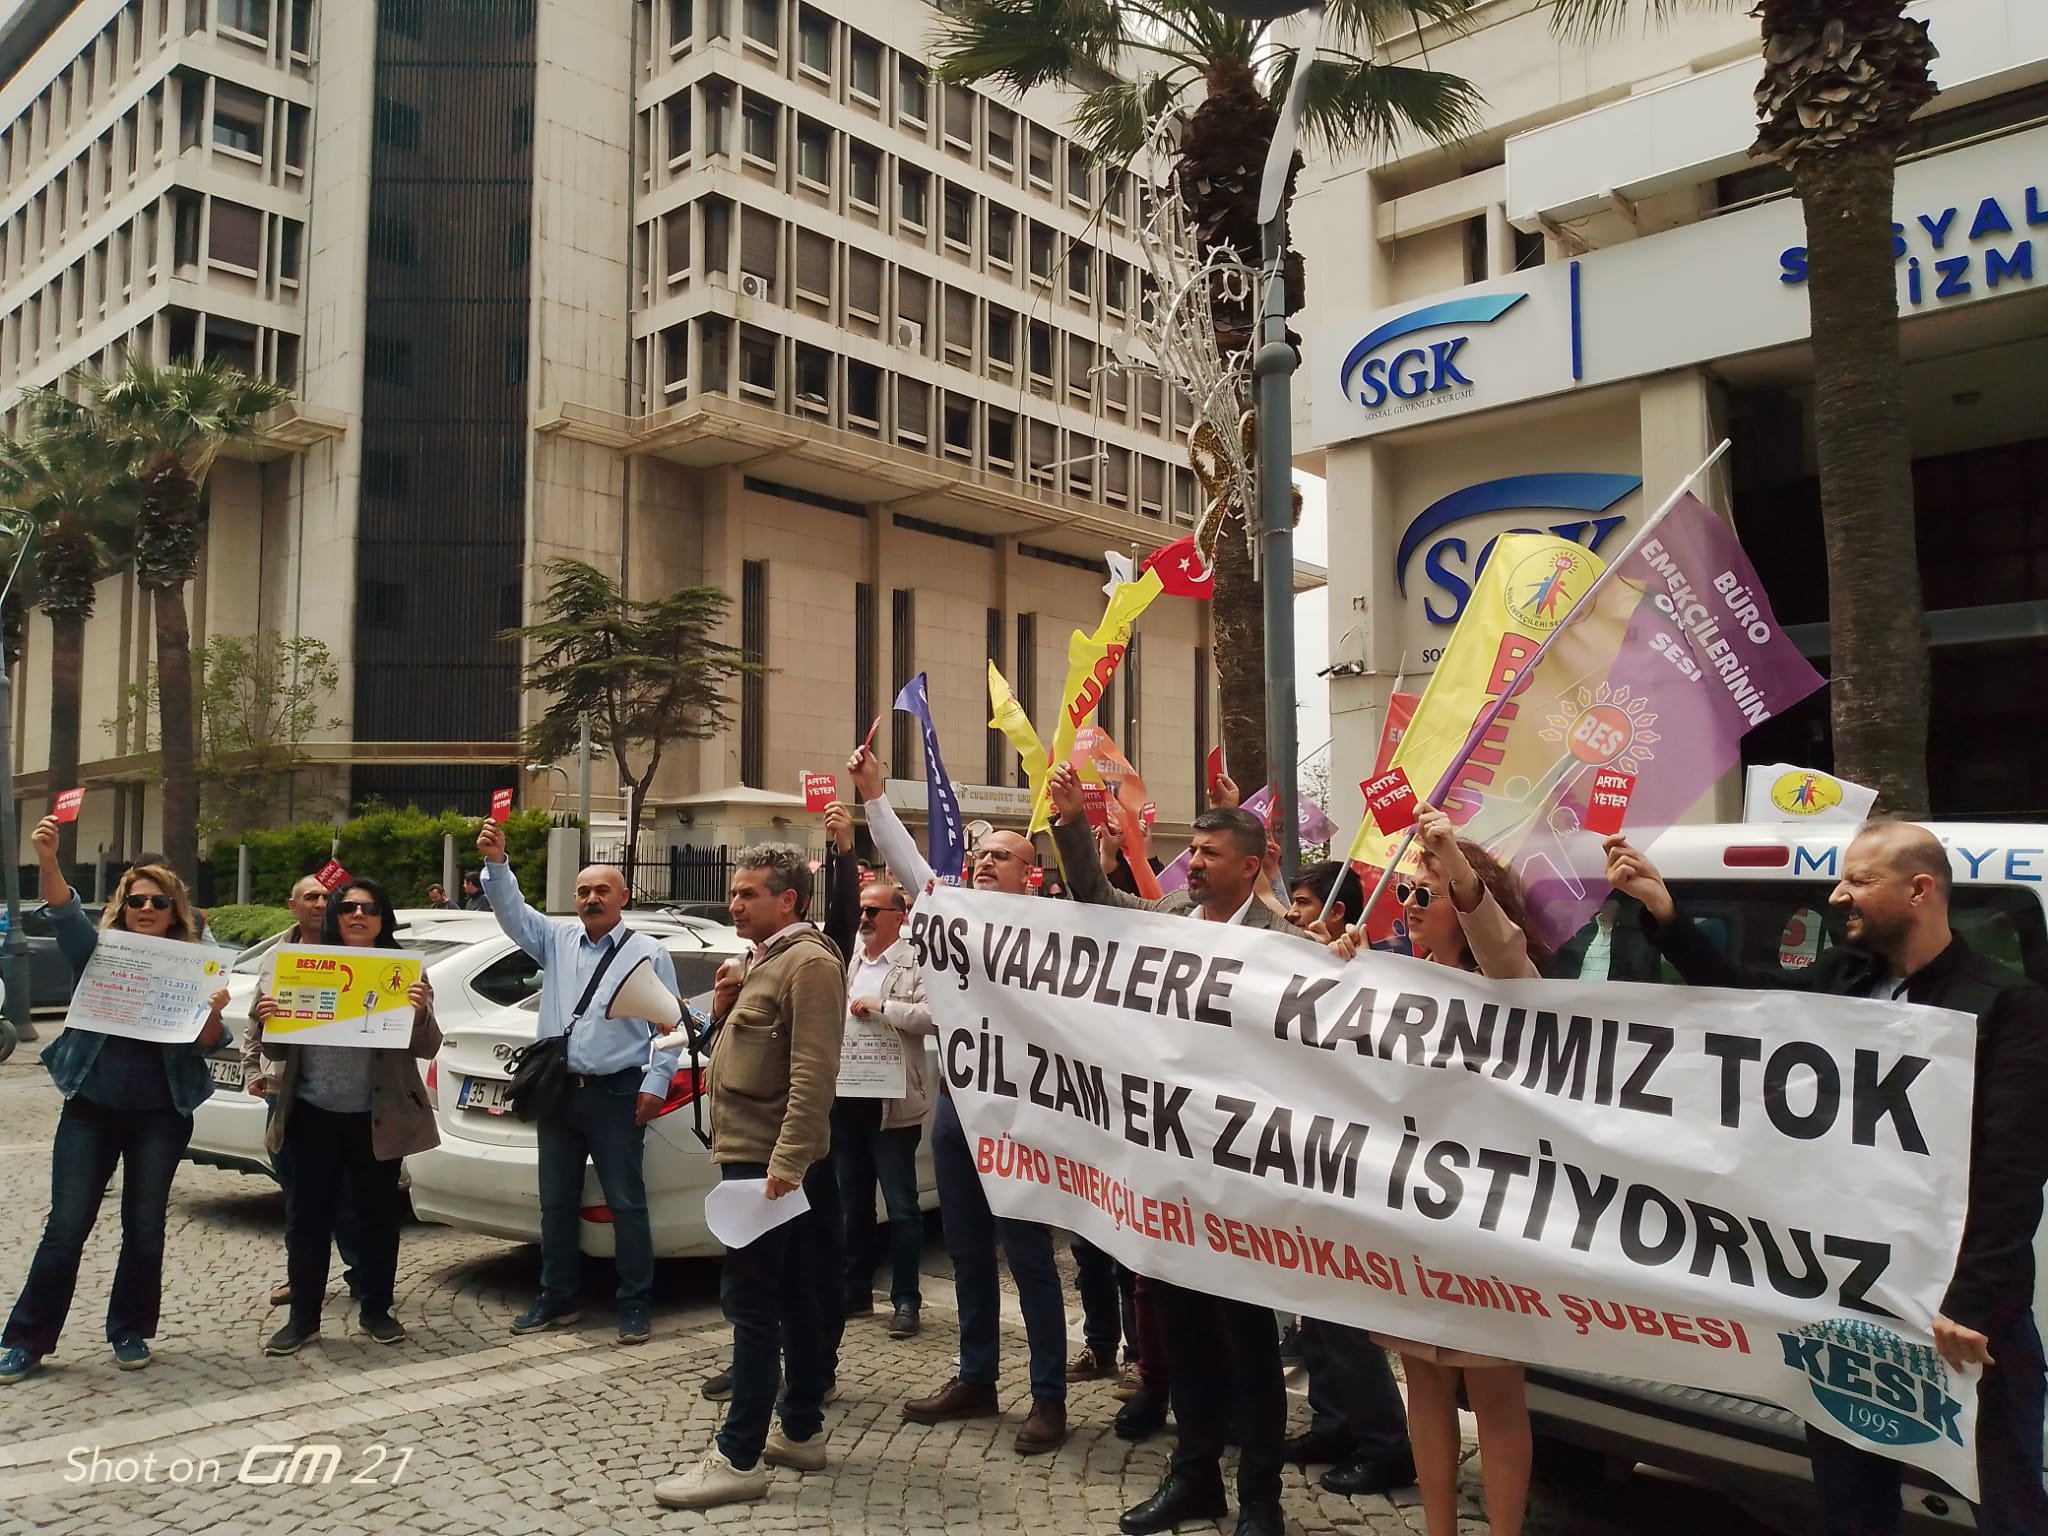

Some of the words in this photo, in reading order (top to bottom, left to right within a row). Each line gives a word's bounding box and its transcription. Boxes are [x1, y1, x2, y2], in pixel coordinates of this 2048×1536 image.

[1779, 186, 2048, 284] SYAL
[1360, 336, 1475, 409] SGK
[1364, 409, 1392, 421] SOSYAL
[1713, 570, 1771, 644] BÜRO
[1640, 538, 1772, 727] EMEKÇİLERİNİN
[1573, 714, 1624, 757] BES
[807, 776, 832, 786] ARTIK
[1365, 772, 1401, 797] ARTIK
[1372, 784, 1412, 810] YETER
[1593, 793, 1628, 808] YETER
[1596, 775, 1628, 789] ARTIK
[296, 958, 337, 971] BES/AR
[912, 912, 970, 991] BOŞ
[984, 922, 1244, 1028] VAADLERE
[1274, 974, 1676, 1117] KARNIMIZ
[1704, 1031, 1931, 1156] TOK
[470, 1082, 486, 1103] 35
[936, 1016, 1017, 1099] CİL
[1028, 1043, 1111, 1131] ZAM
[1121, 1072, 1194, 1160] EK
[1212, 1094, 1369, 1199] ZAM
[1386, 1115, 1906, 1320] İSTİYORUZ
[977, 1132, 1050, 1186] BÜRO
[1054, 1154, 1195, 1247] EMEKÇİLERİ
[1206, 1212, 1406, 1296] SENDİKASI
[1414, 1254, 1552, 1319] İZMİR
[1776, 1332, 1964, 1448] KESK
[1848, 1404, 1900, 1439] 1995
